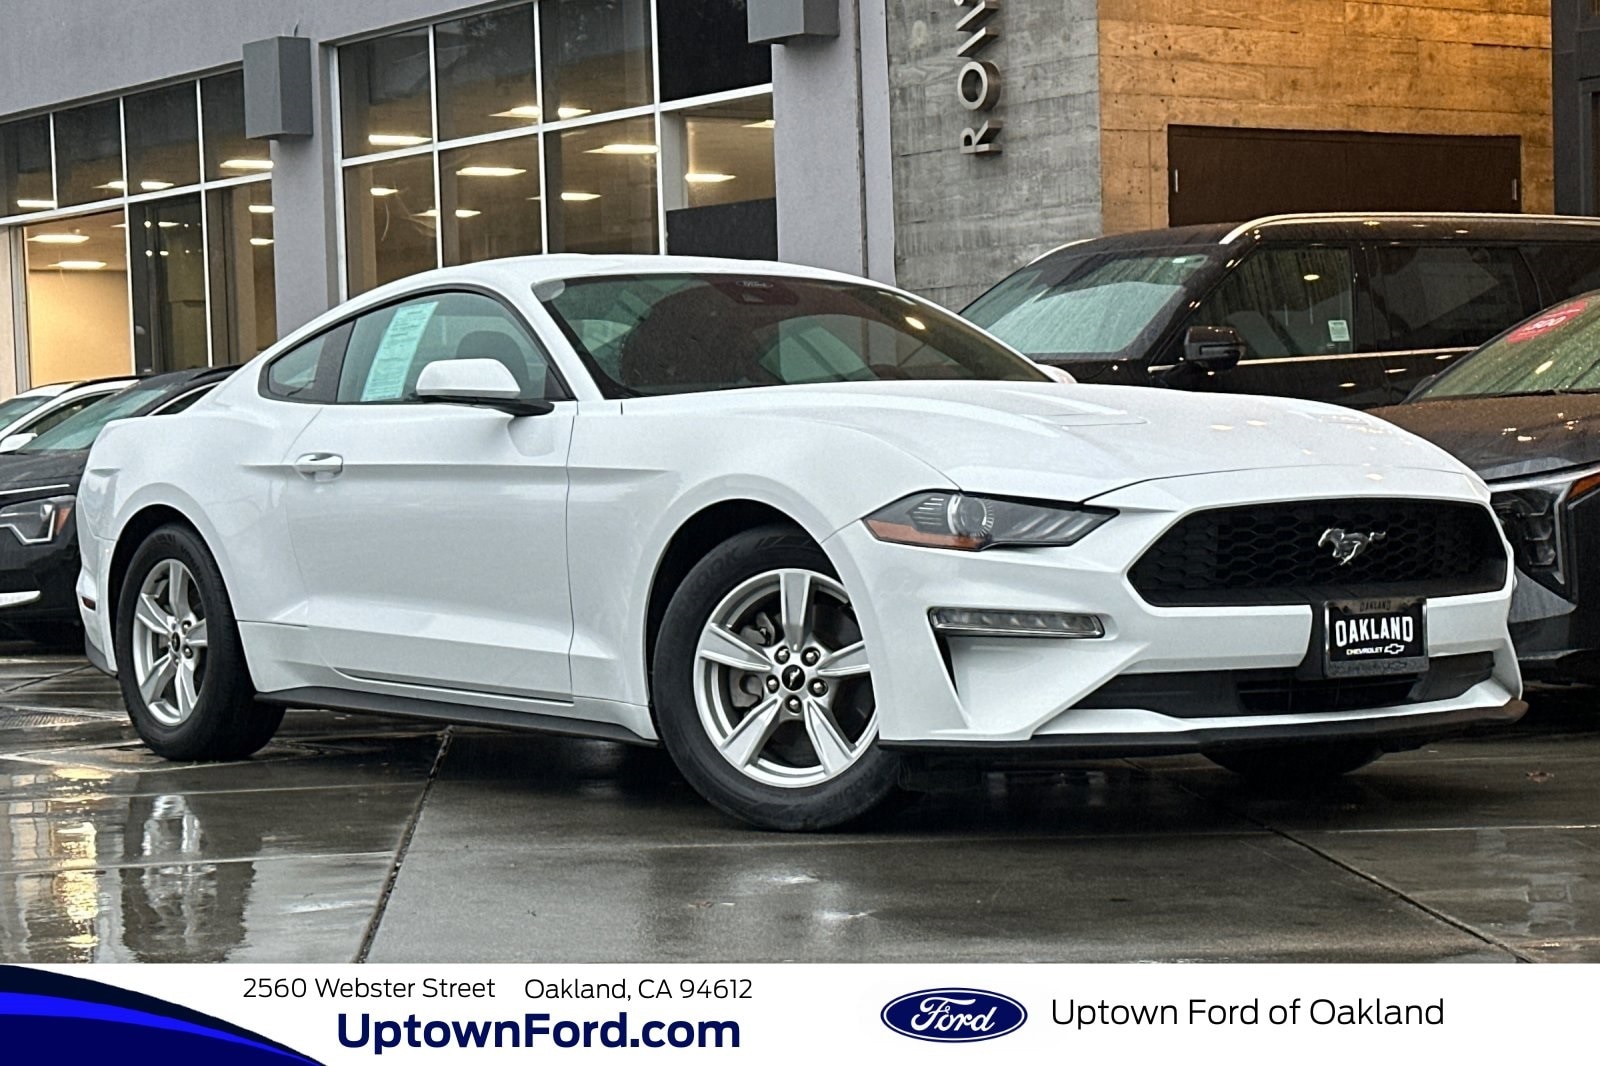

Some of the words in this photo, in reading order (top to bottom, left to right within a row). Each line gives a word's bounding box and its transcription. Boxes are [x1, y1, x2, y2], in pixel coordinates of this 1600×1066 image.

[1359, 600, 1392, 612] OAKLAND
[1335, 616, 1414, 647] OAKLAND
[1346, 646, 1383, 656] CHEVROLET
